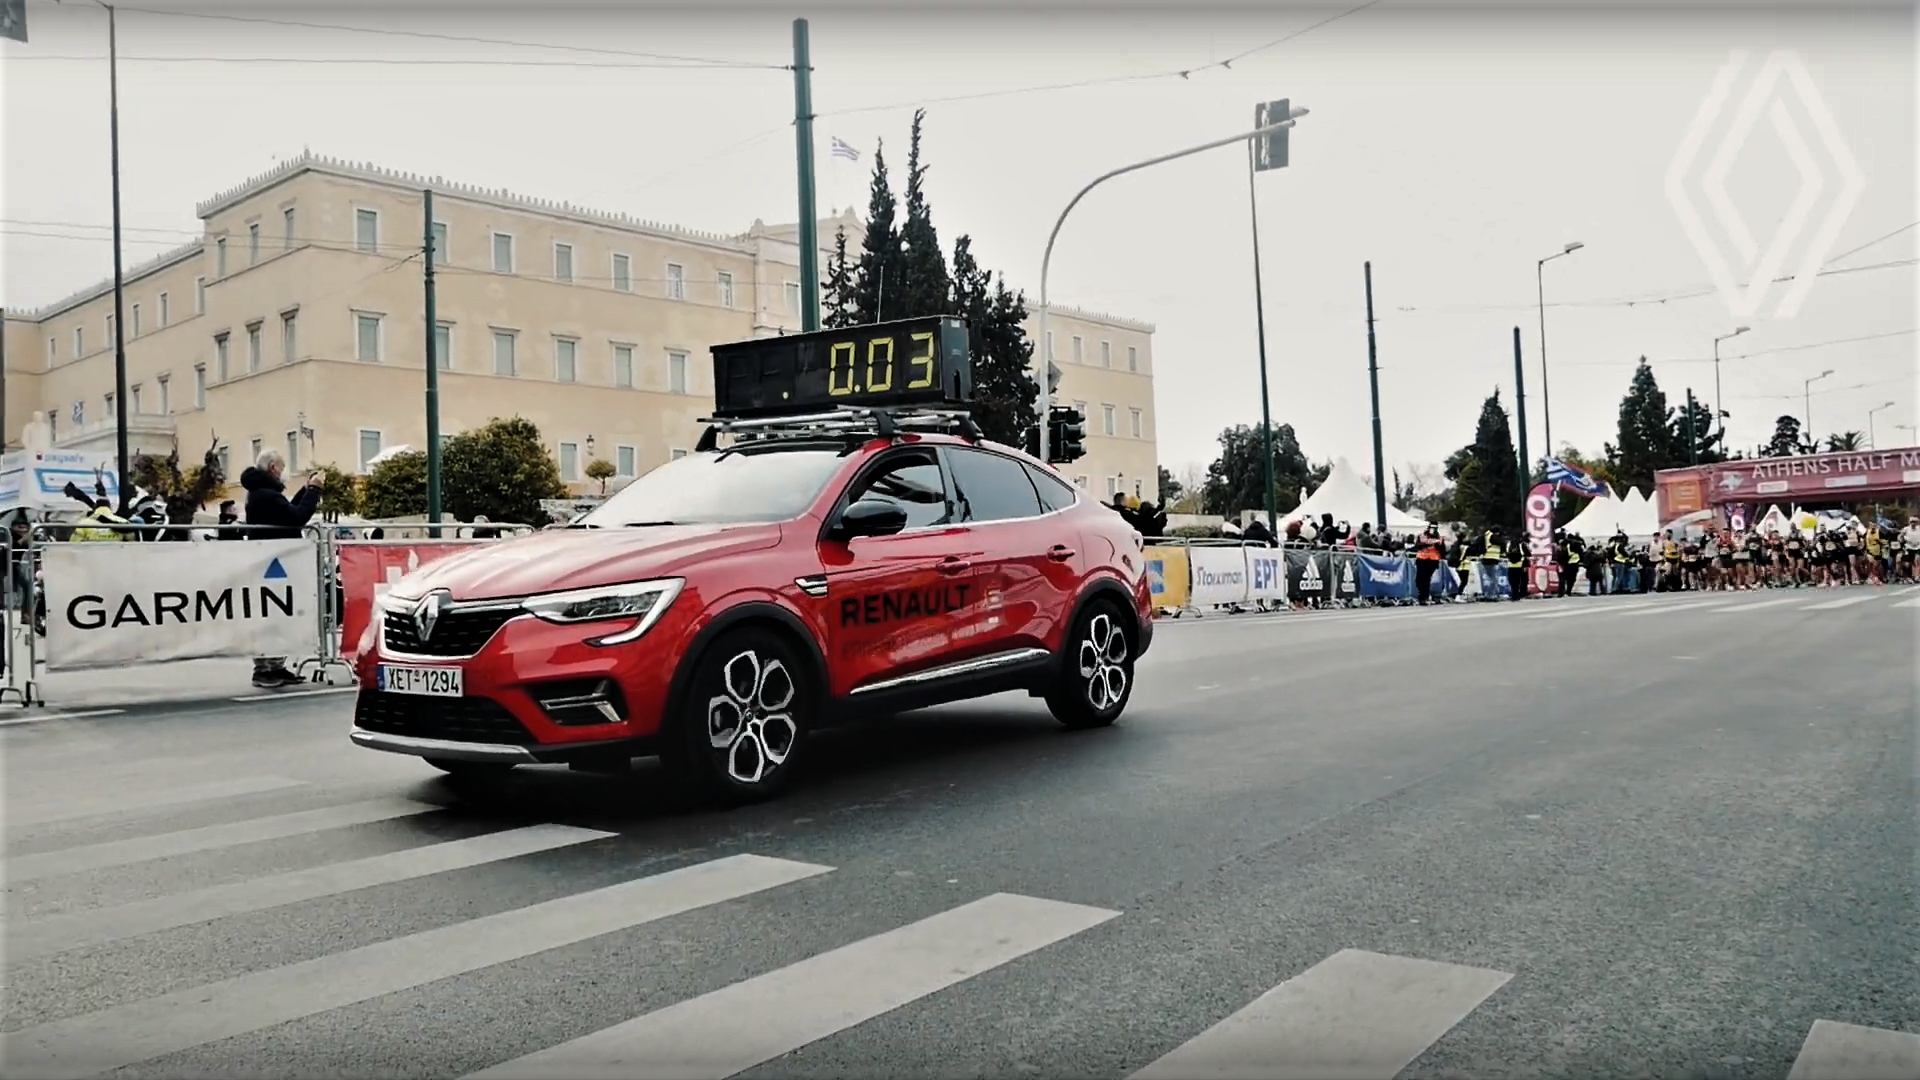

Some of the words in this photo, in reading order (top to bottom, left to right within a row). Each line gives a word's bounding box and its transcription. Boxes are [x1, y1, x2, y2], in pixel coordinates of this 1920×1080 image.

[1751, 459, 1831, 479] ATHENS
[1837, 454, 1892, 472] HALF
[66, 585, 293, 629] GARMIN
[841, 584, 971, 628] RENAULT
